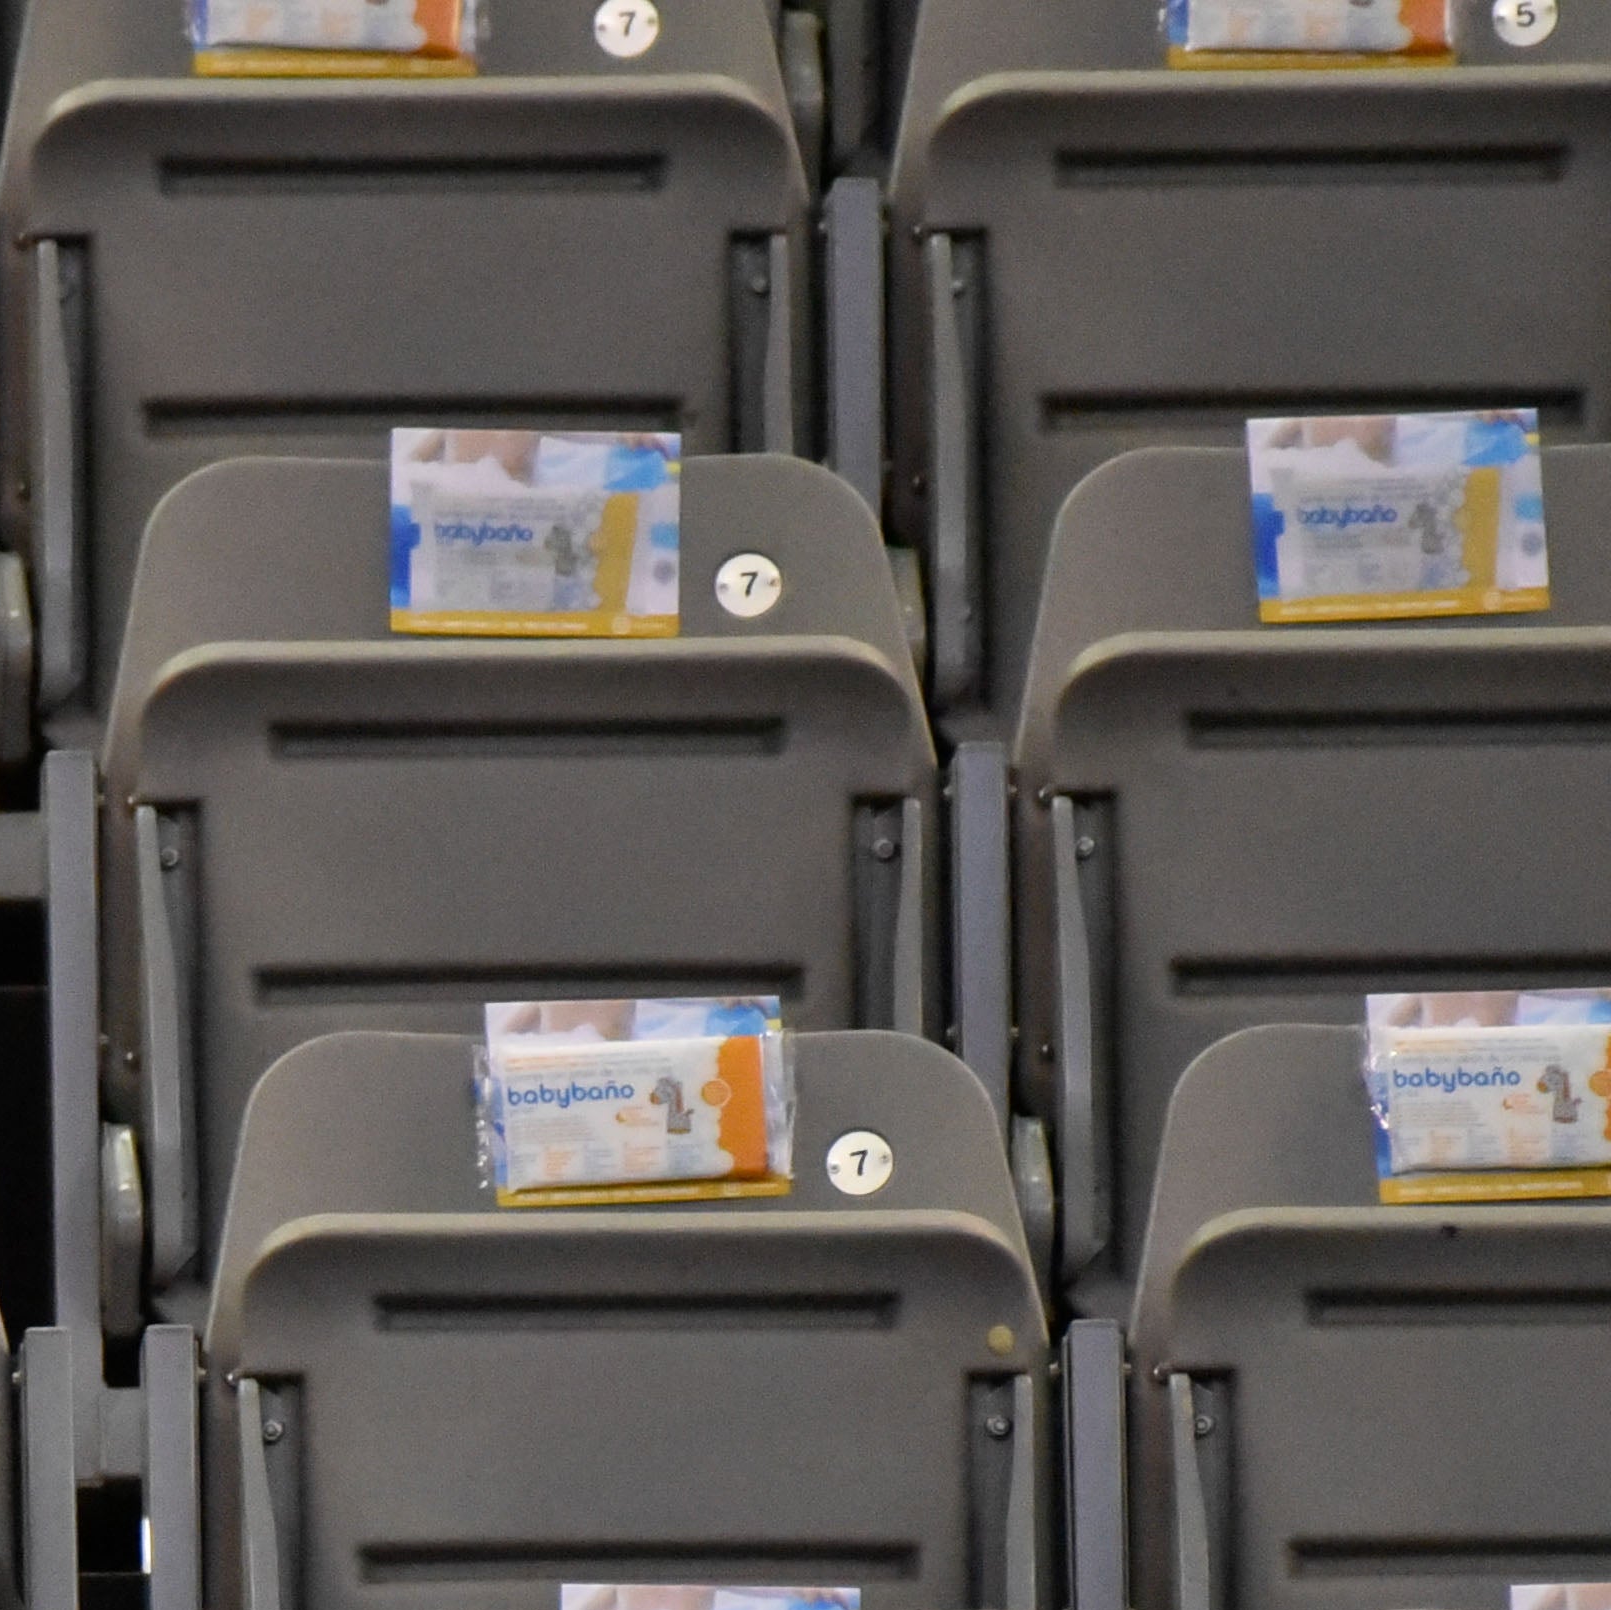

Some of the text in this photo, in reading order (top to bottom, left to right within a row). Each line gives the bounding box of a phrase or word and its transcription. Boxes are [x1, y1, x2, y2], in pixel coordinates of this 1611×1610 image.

[618, 11, 636, 36] 7
[1516, 3, 1535, 28] 5
[740, 571, 759, 598] 7
[1393, 1067, 1521, 1093] babybaño
[508, 1081, 635, 1108] babybaño
[849, 1149, 869, 1176] 7
